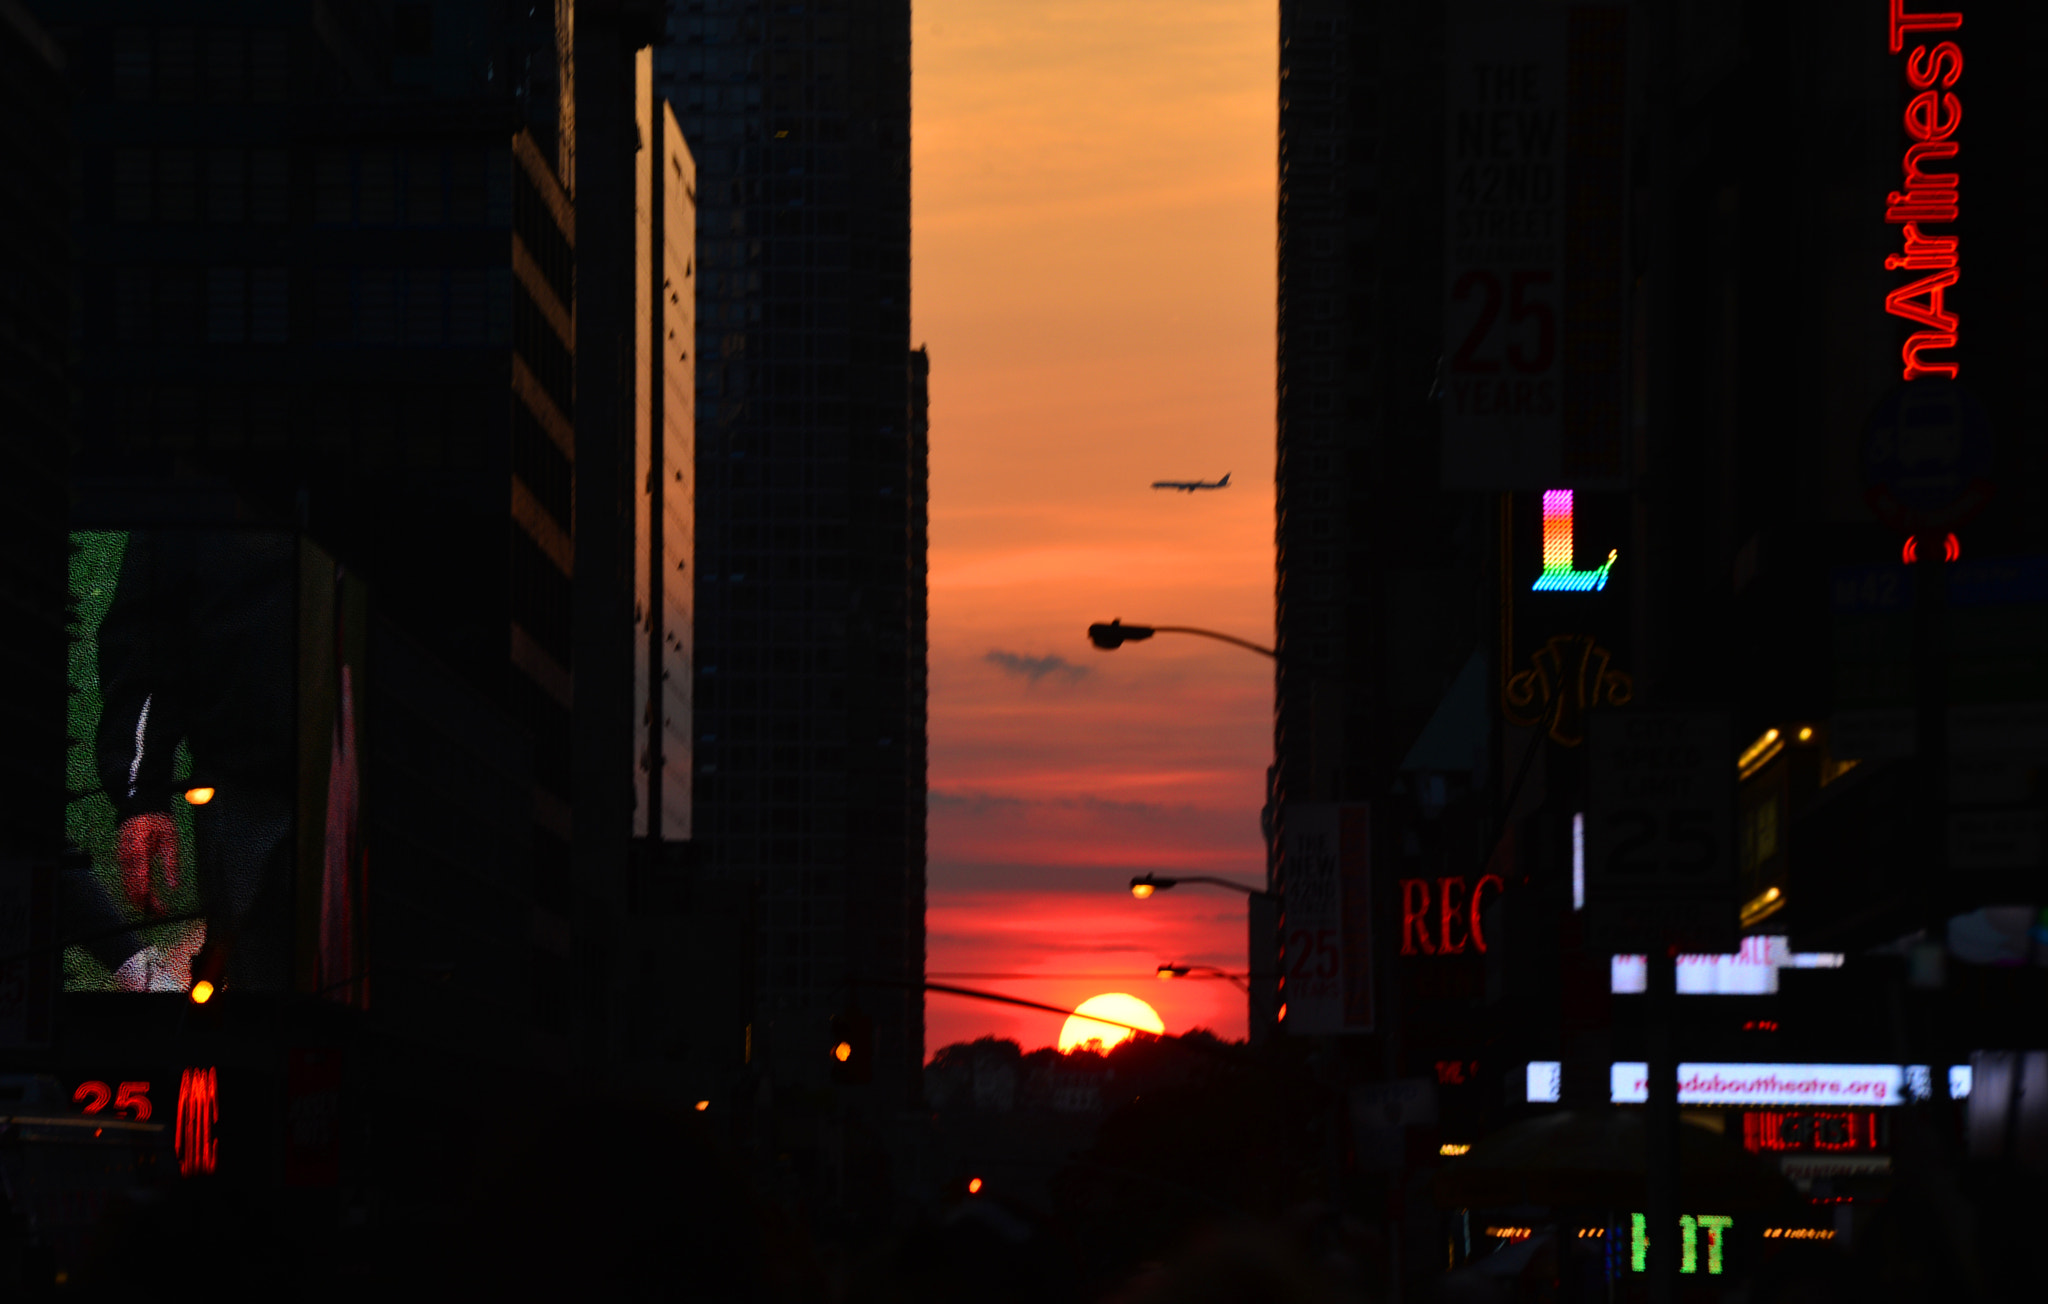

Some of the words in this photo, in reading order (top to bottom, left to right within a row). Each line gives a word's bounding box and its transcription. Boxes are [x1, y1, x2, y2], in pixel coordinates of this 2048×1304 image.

[1472, 63, 1541, 104] THE
[1457, 109, 1557, 159] NEW
[1456, 163, 1555, 205] 42ND
[1456, 208, 1555, 240] STREET
[1452, 271, 1554, 373] 25
[1453, 381, 1555, 415] YEARS
[1298, 833, 1328, 850] THE
[1606, 809, 1719, 875] 25
[1290, 854, 1337, 877] NEW
[1290, 879, 1336, 901] 42ND
[1290, 928, 1338, 979] 25
[72, 1080, 153, 1123] 25
